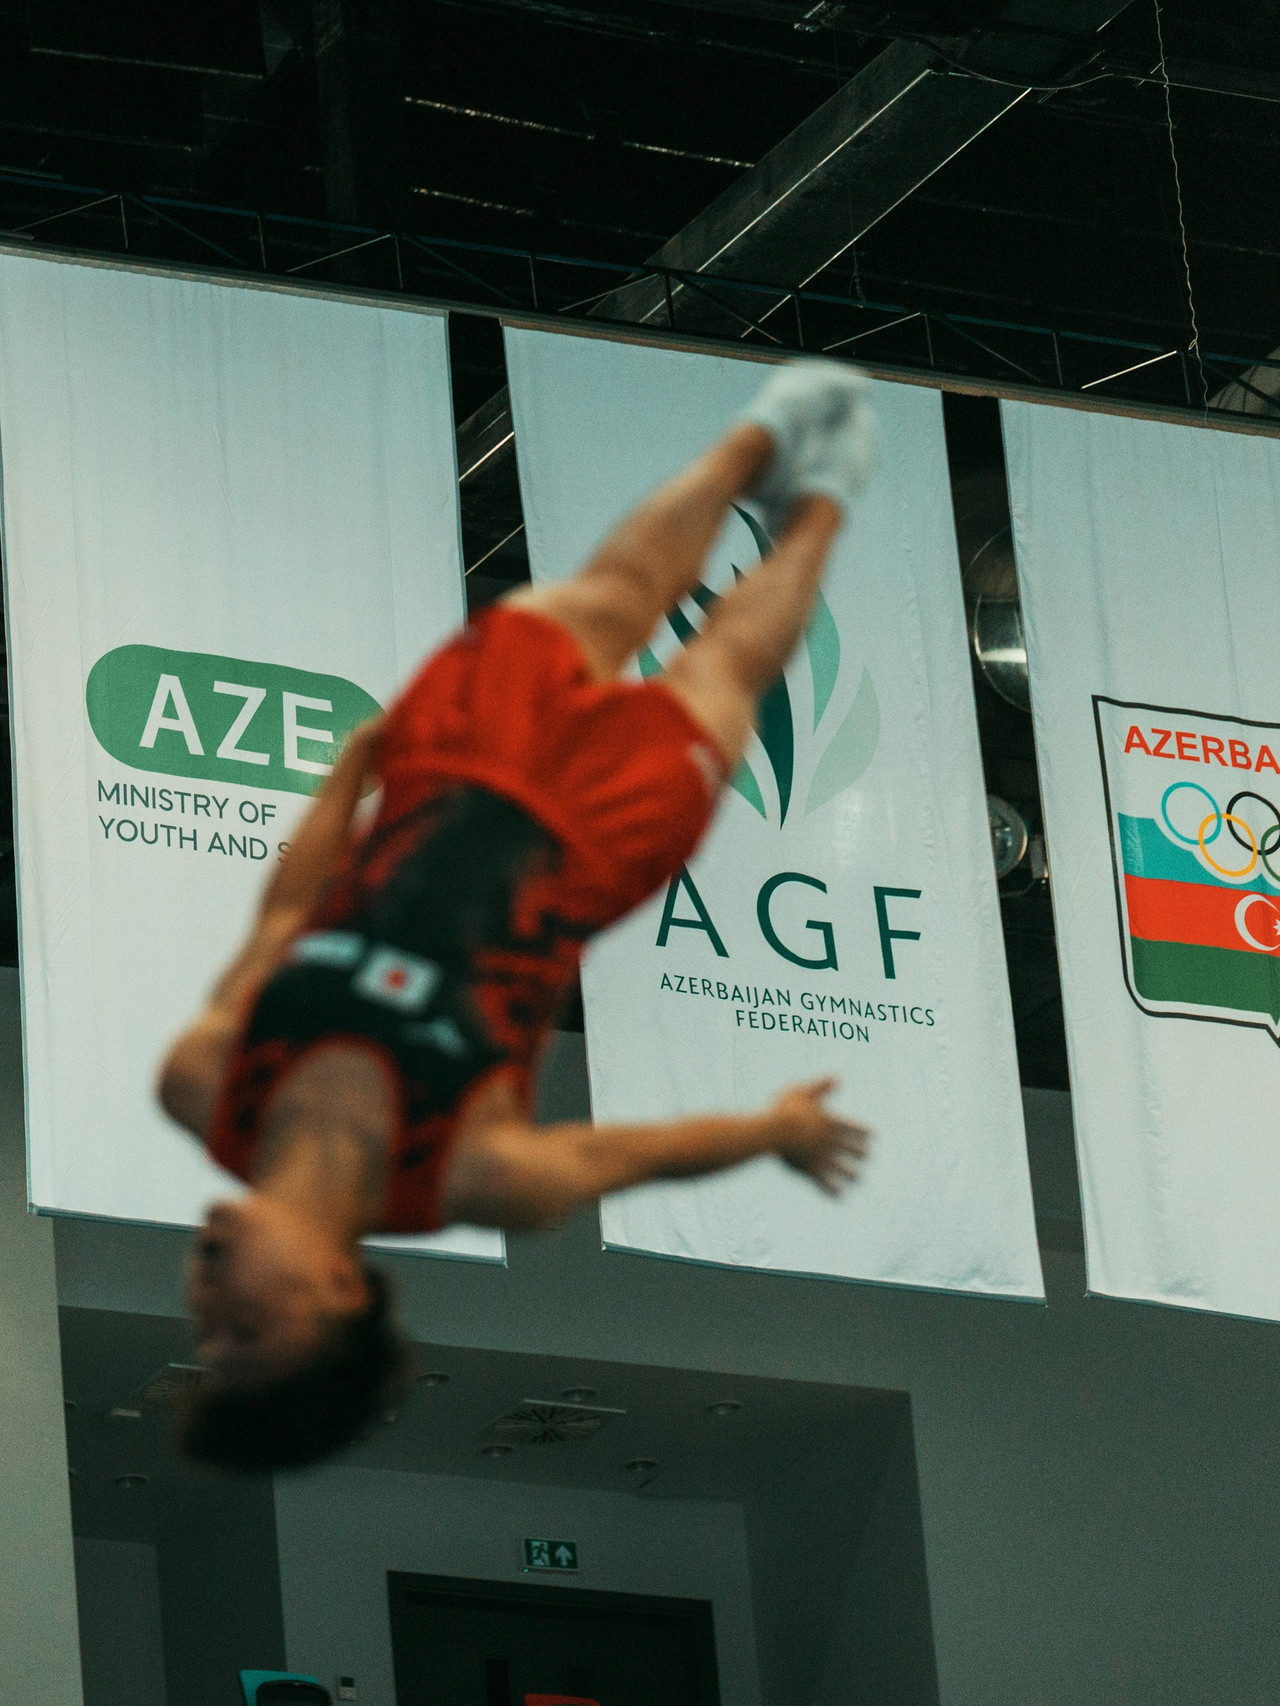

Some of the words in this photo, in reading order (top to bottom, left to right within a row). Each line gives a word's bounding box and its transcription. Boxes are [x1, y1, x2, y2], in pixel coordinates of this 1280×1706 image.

[138, 673, 335, 777] AZE
[97, 779, 230, 819] MINISTRY
[238, 800, 277, 826] OF
[97, 815, 198, 851] YOUTH
[206, 831, 269, 861] AND
[655, 863, 923, 980] AGF
[659, 972, 792, 1009] AZERBAIJAN
[800, 991, 936, 1027] GYMNASTICS
[735, 1009, 871, 1044] FEDERATION
